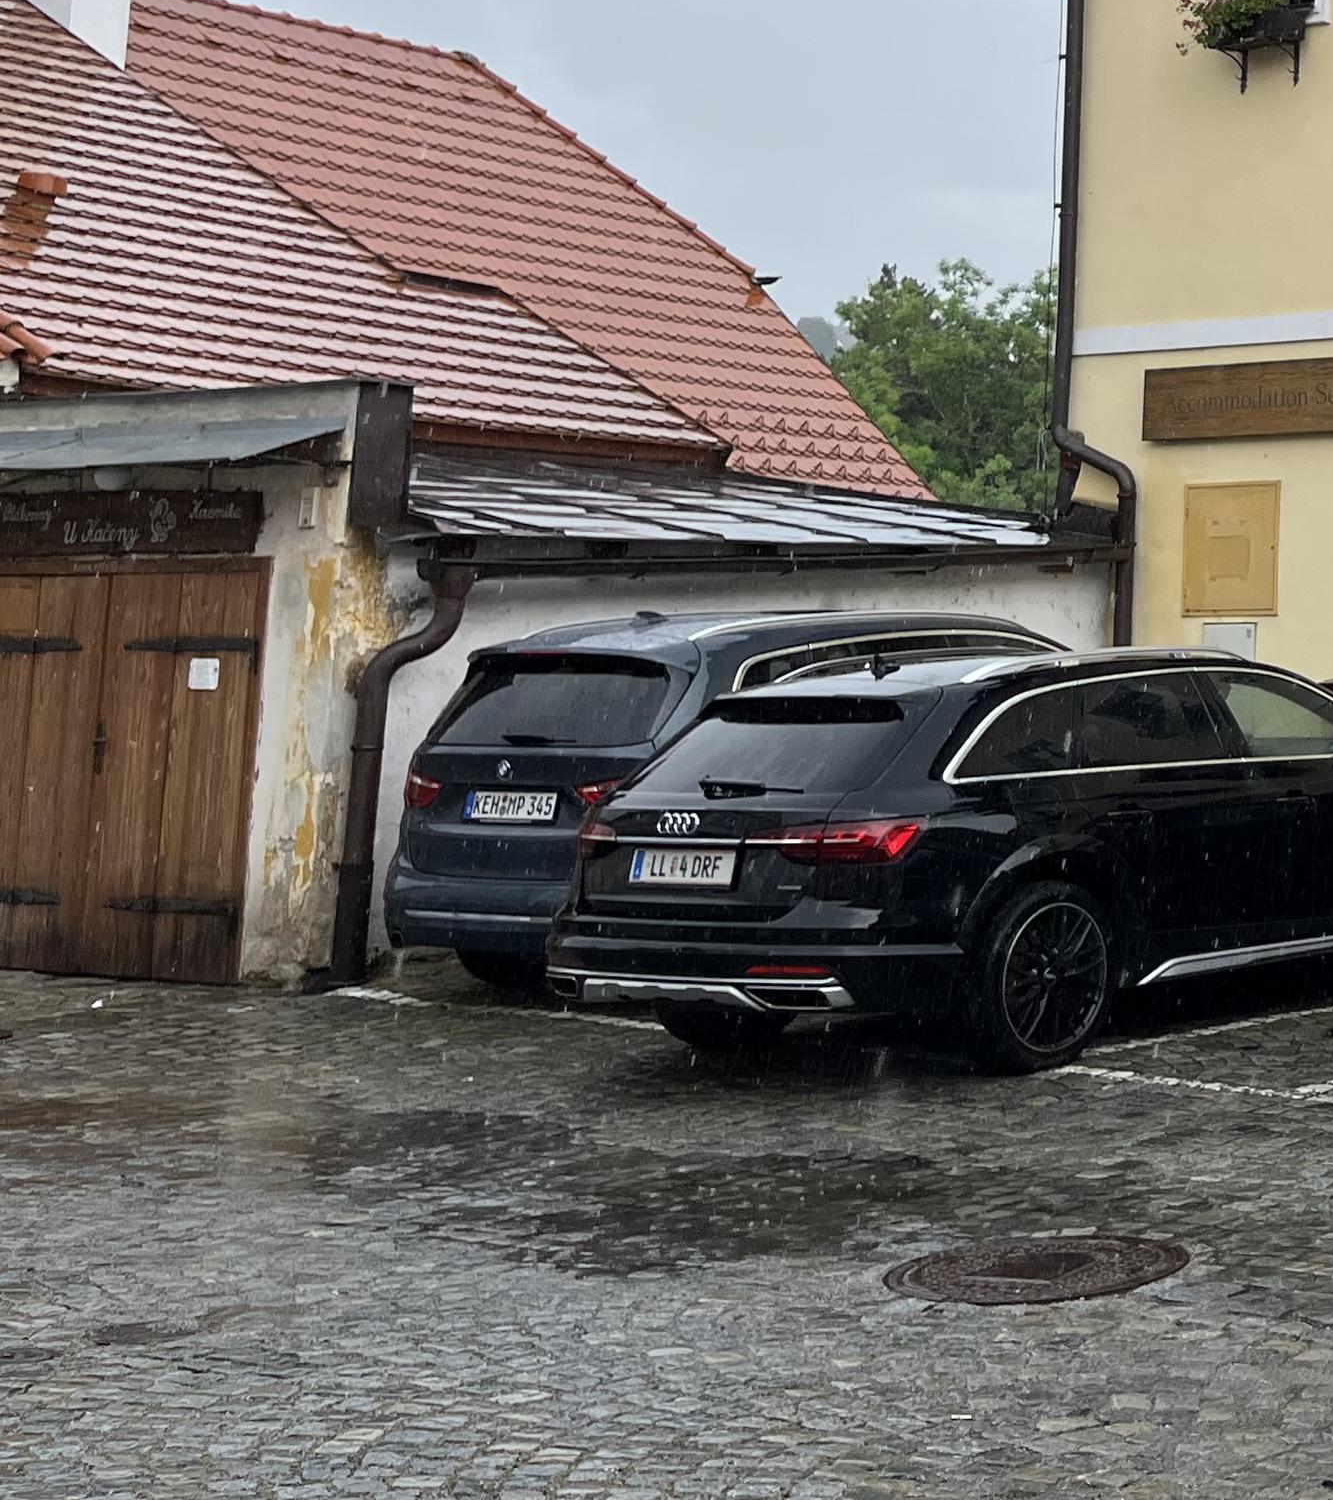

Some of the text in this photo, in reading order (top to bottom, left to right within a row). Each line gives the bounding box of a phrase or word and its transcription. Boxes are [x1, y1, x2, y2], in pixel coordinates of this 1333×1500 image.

[1162, 386, 1309, 415] Accommodation
[473, 795, 500, 814] KEH
[528, 795, 553, 815] 345
[649, 853, 666, 877] LL
[690, 855, 723, 879] DRF
